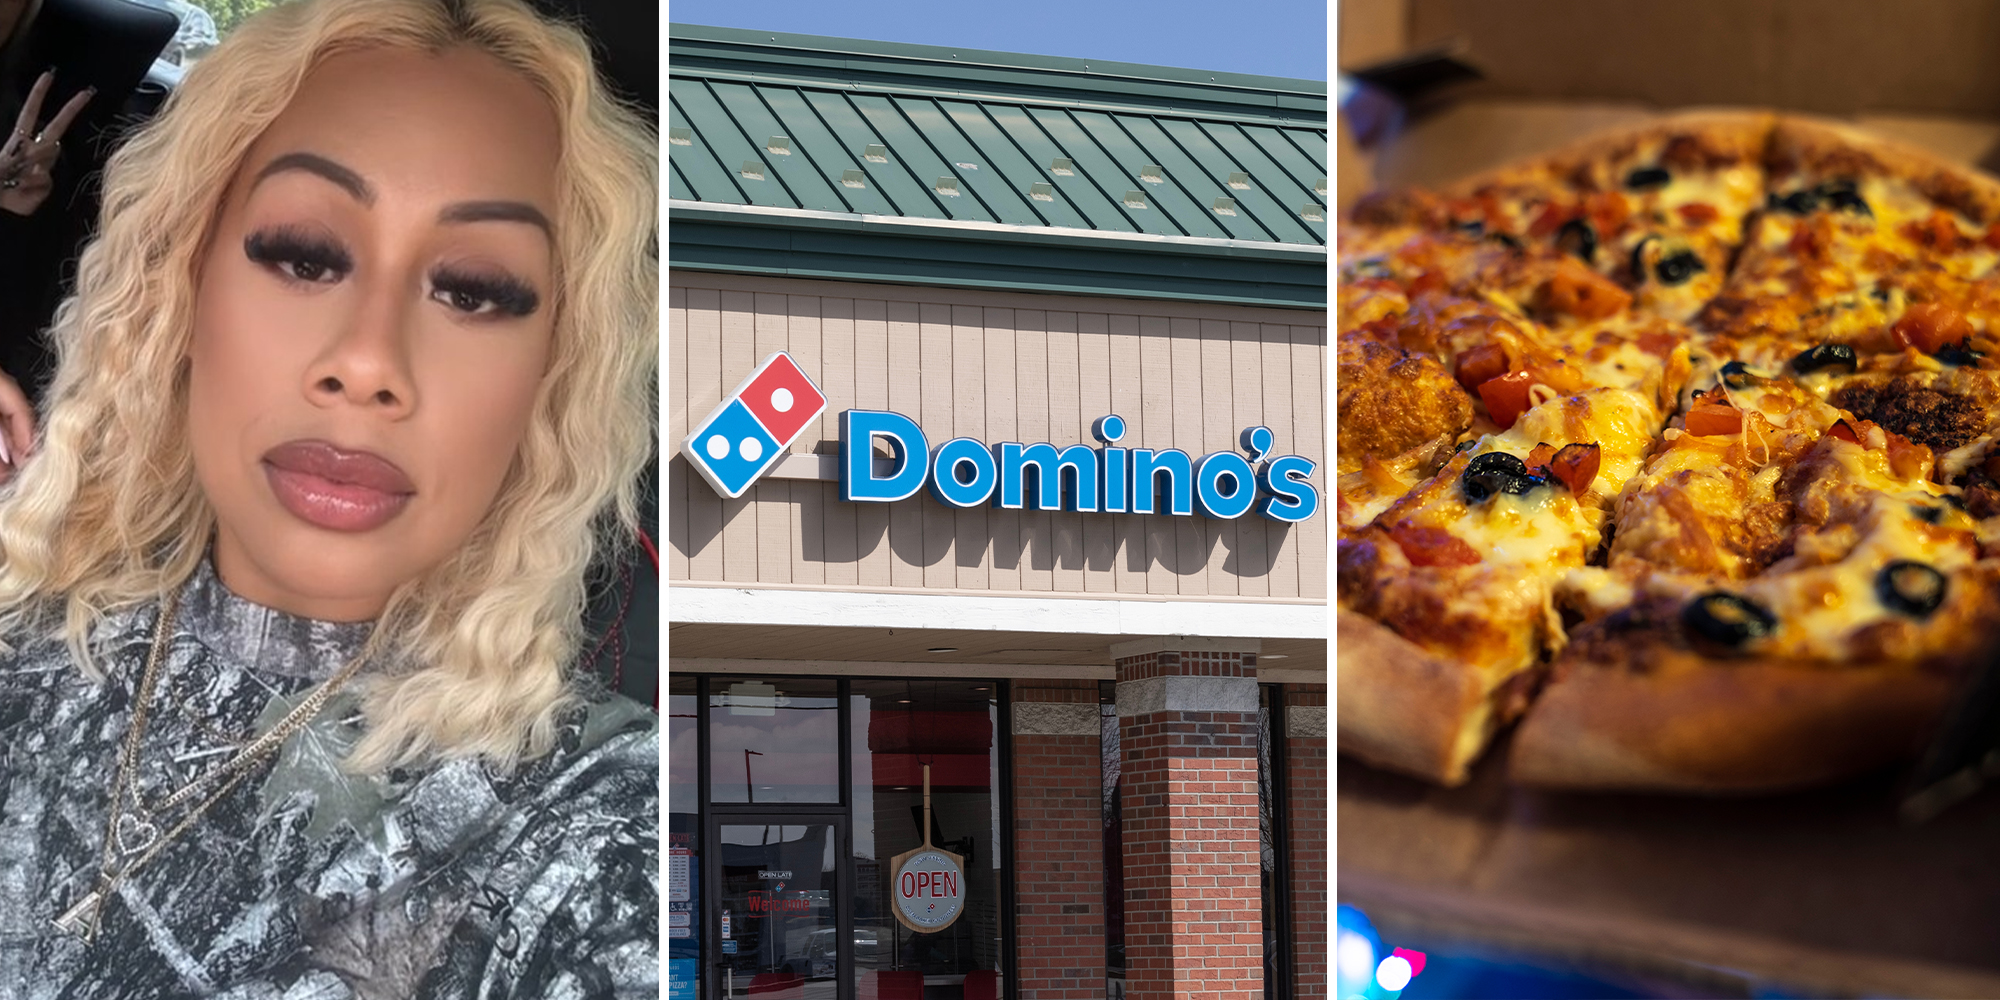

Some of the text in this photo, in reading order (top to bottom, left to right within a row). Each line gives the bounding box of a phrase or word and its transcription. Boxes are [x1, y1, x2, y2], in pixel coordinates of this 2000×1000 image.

[840, 409, 1319, 523] Domino's
[901, 870, 957, 899] OPEN
[748, 896, 810, 912] Welcome
[669, 981, 688, 989] PIZZA?
